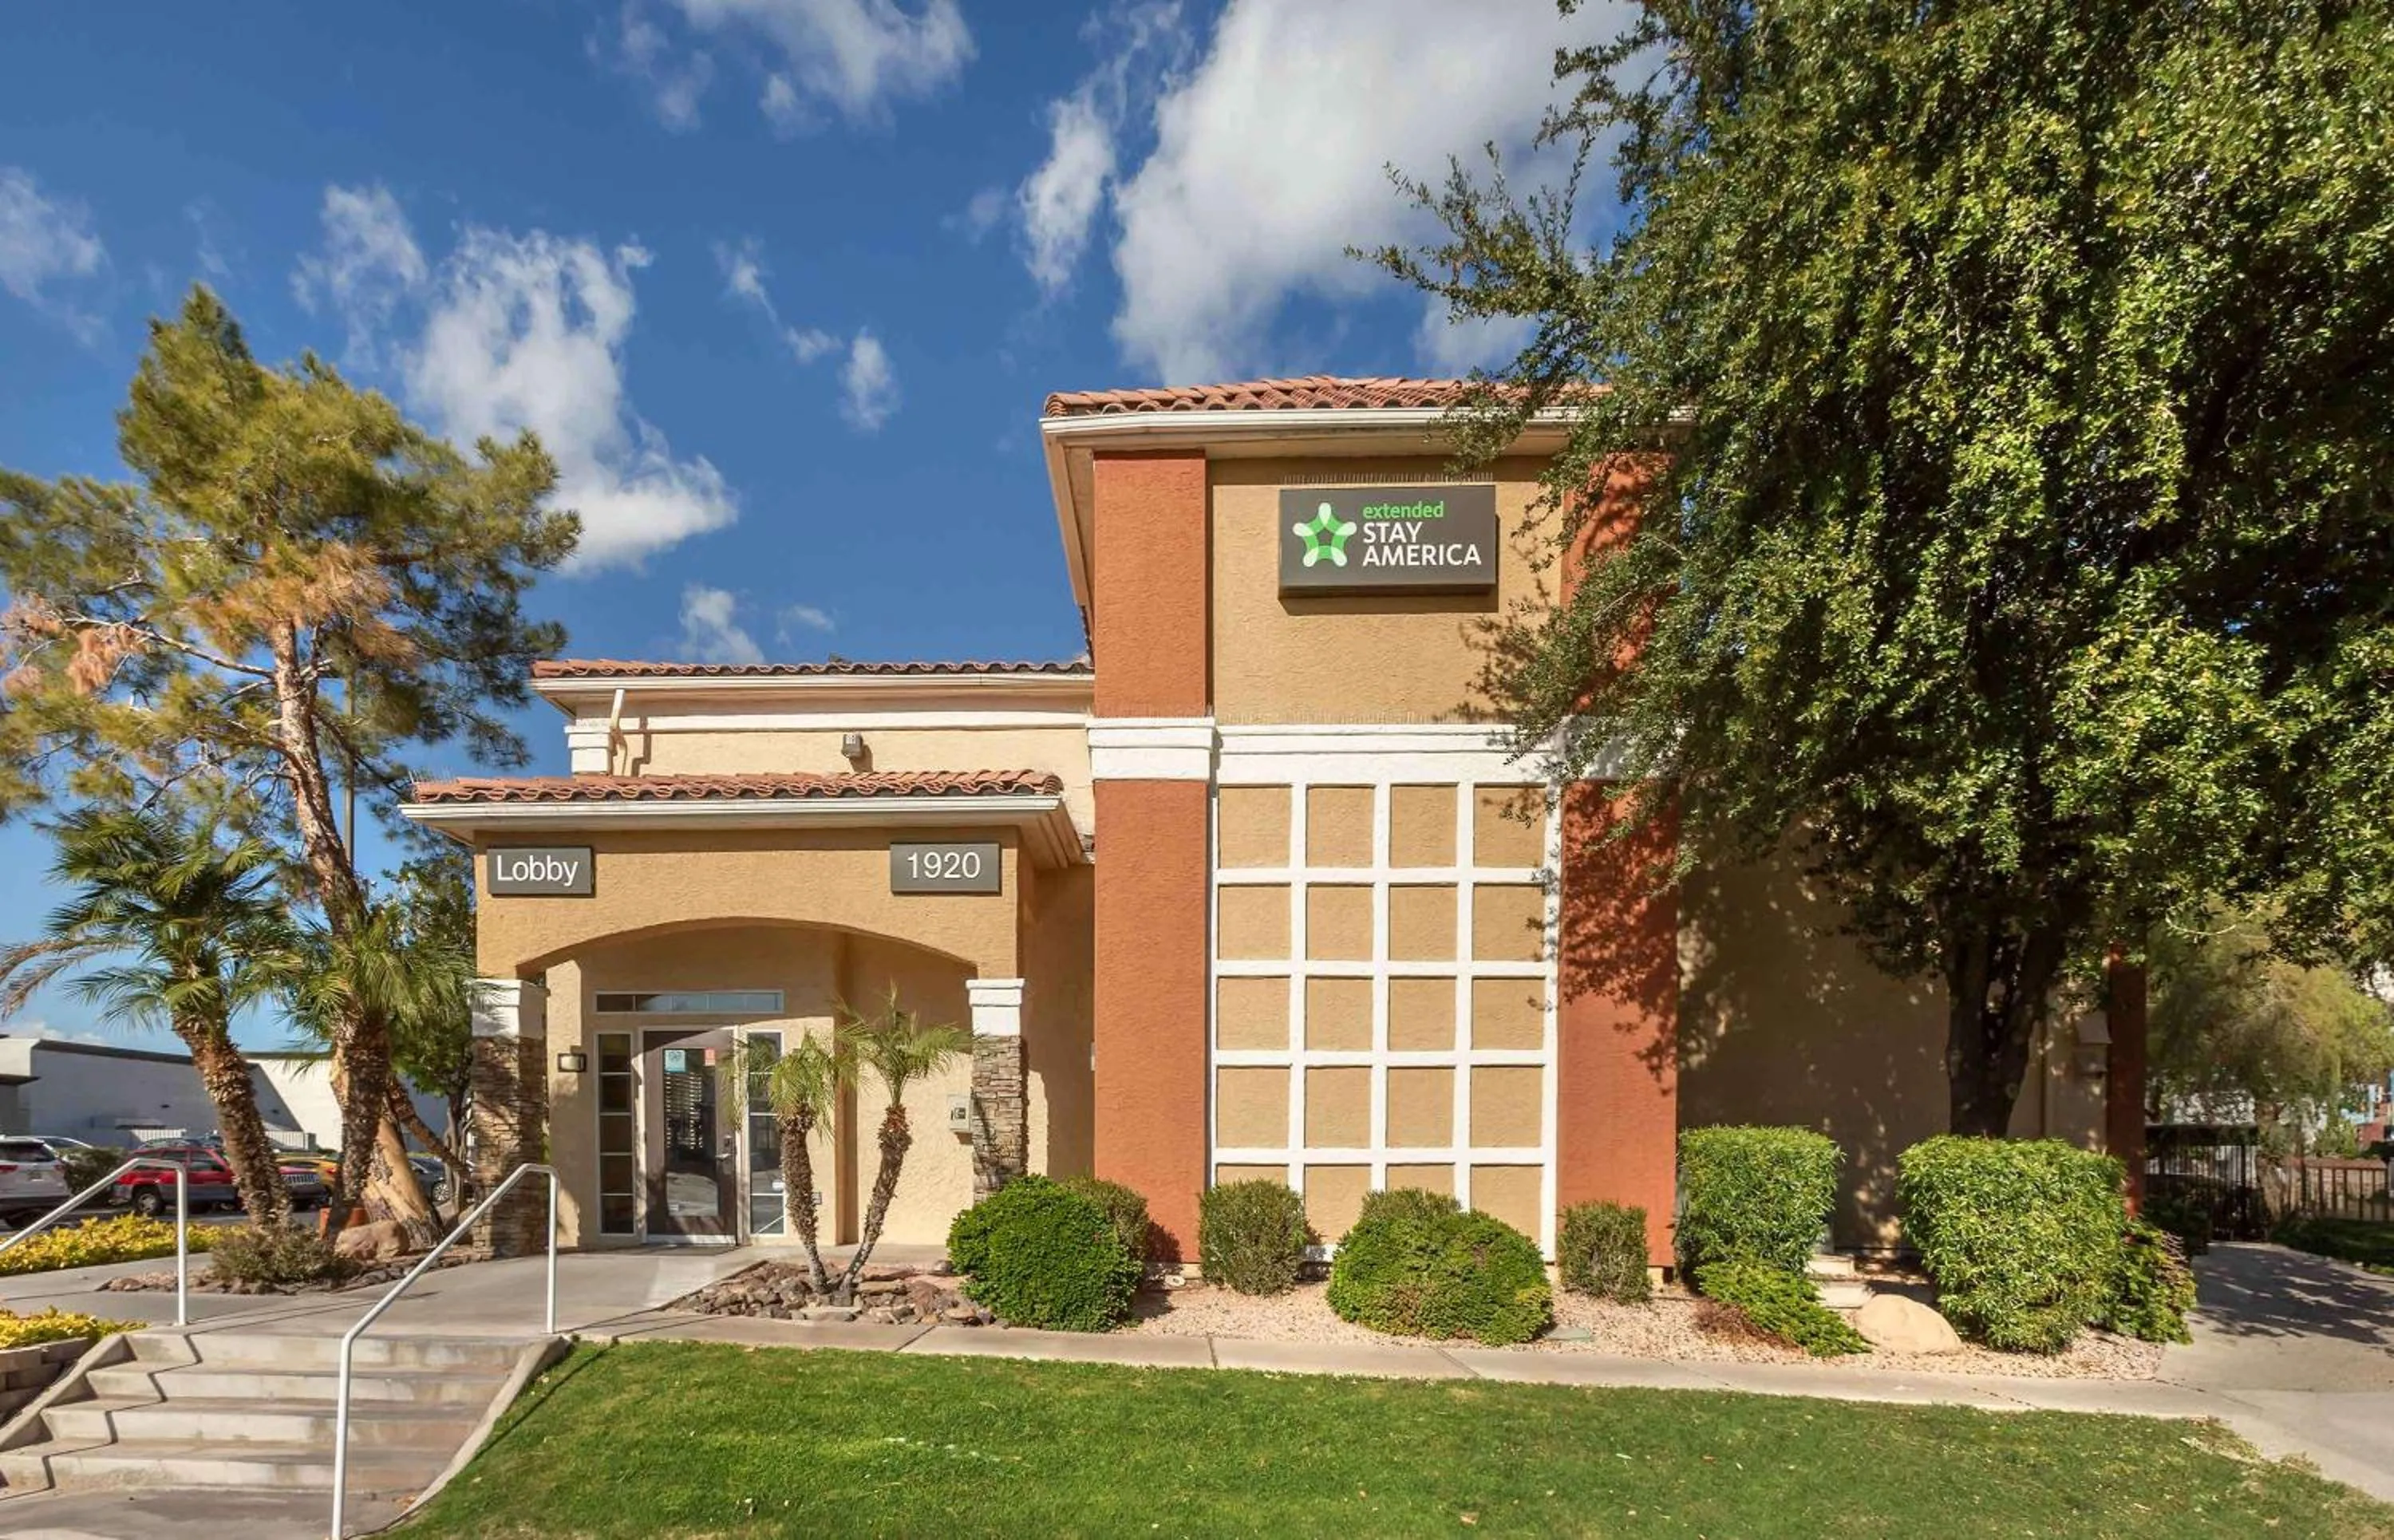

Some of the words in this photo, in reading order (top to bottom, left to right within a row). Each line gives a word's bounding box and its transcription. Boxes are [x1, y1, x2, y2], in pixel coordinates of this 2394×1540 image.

[1362, 500, 1444, 519] extended
[1362, 521, 1423, 543] STAY
[1362, 543, 1482, 567] AMERICA
[497, 855, 579, 886] Lobby
[907, 851, 981, 879] 1920
